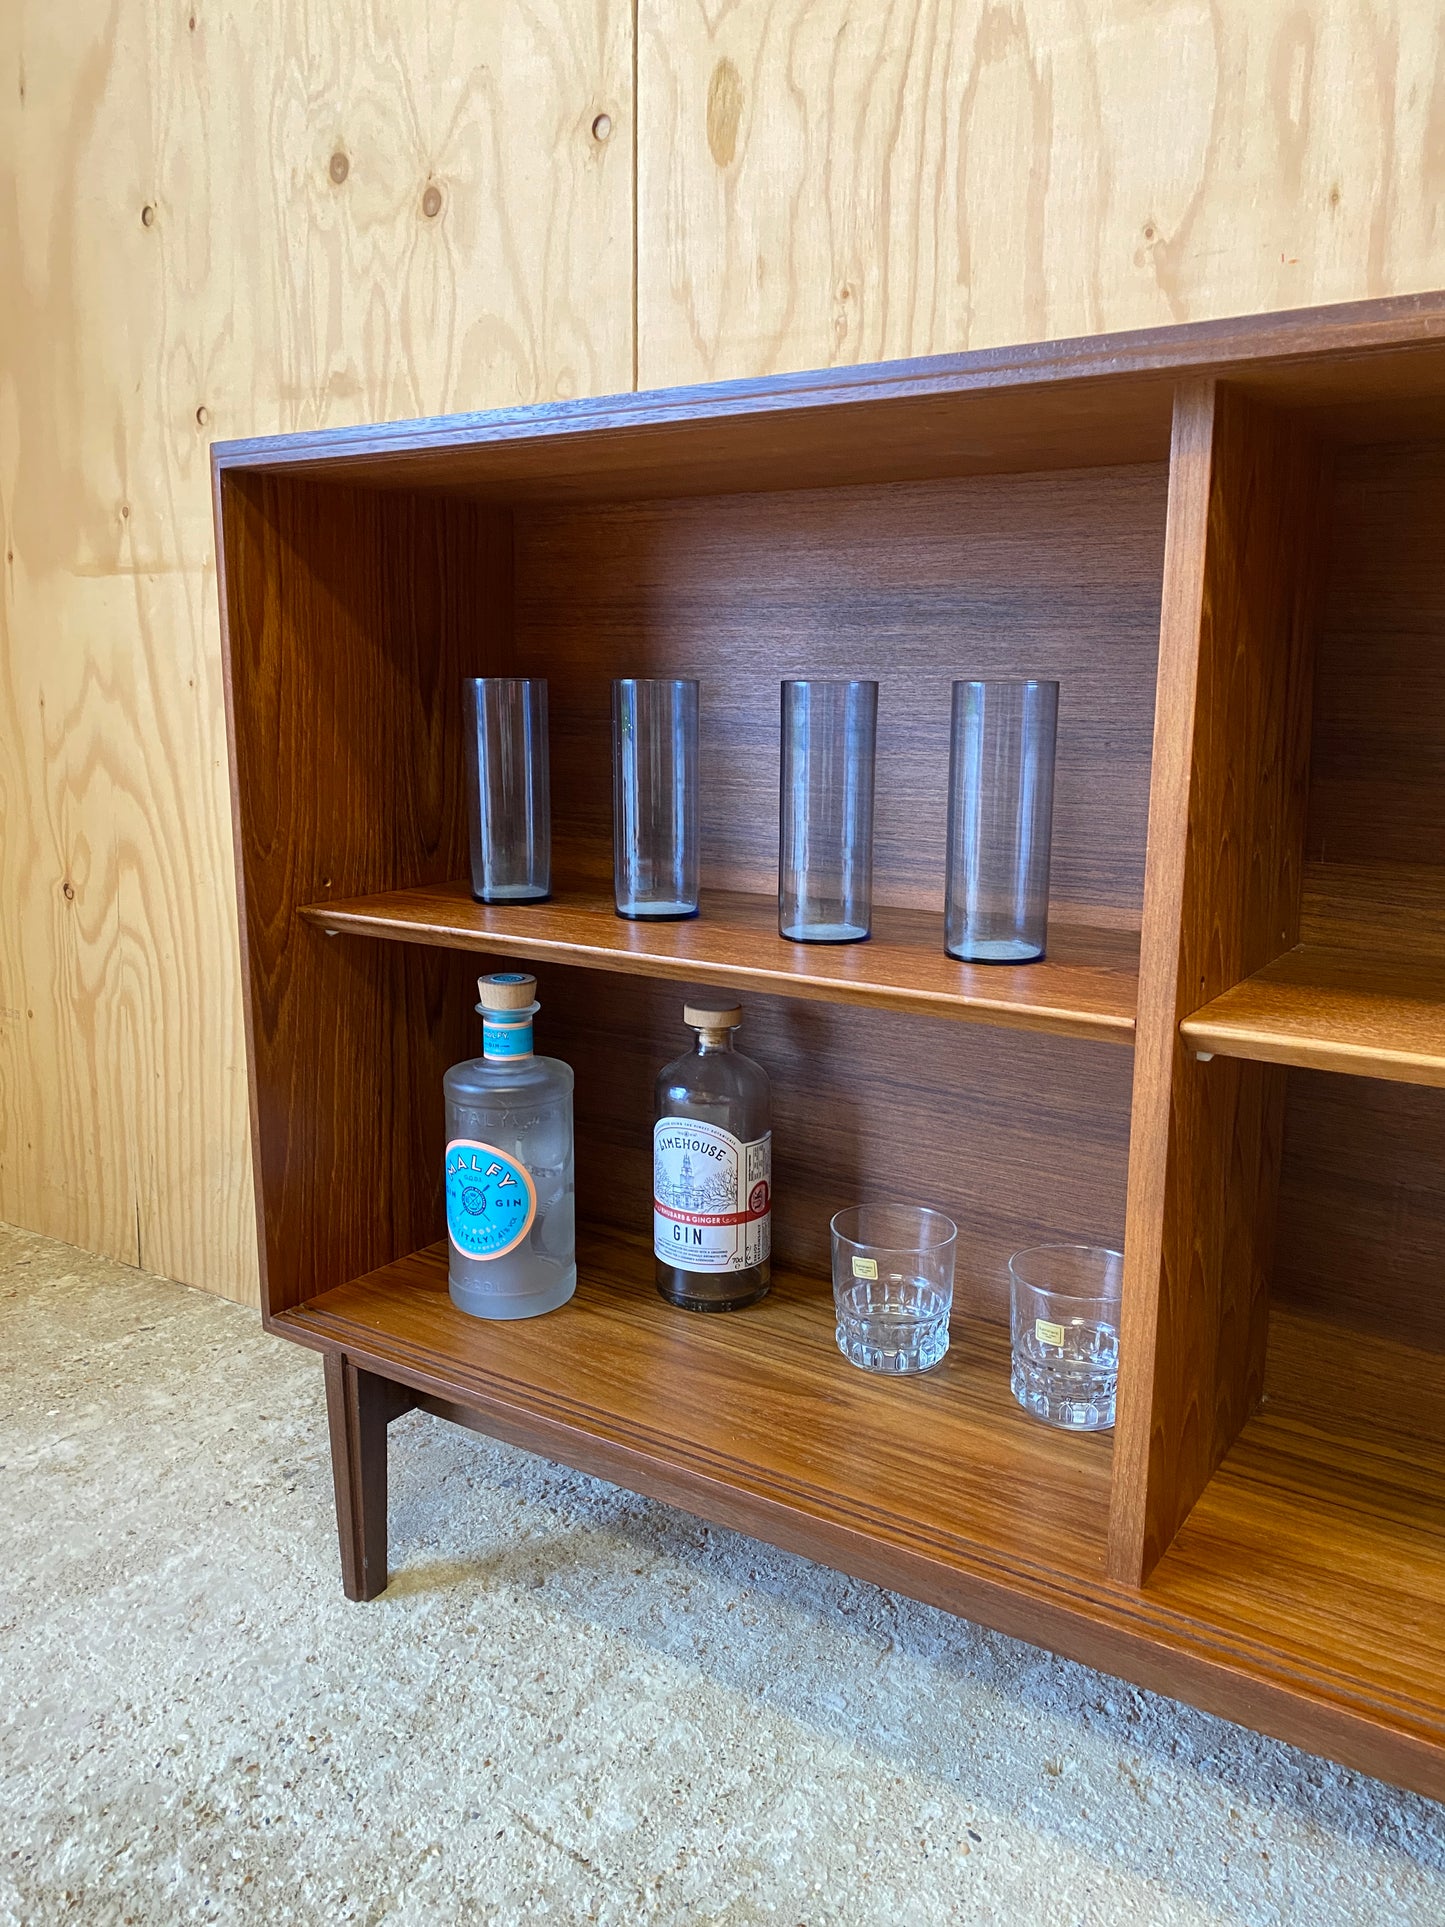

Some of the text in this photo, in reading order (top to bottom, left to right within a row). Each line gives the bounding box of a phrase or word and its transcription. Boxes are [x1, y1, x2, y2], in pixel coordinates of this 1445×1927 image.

[658, 1137, 727, 1162] LIMEHOUSE
[447, 1153, 518, 1188] MALFY
[495, 1199, 522, 1208] GIN
[661, 1208, 721, 1224] RHUBARB & GINGER
[673, 1224, 702, 1246] GIN
